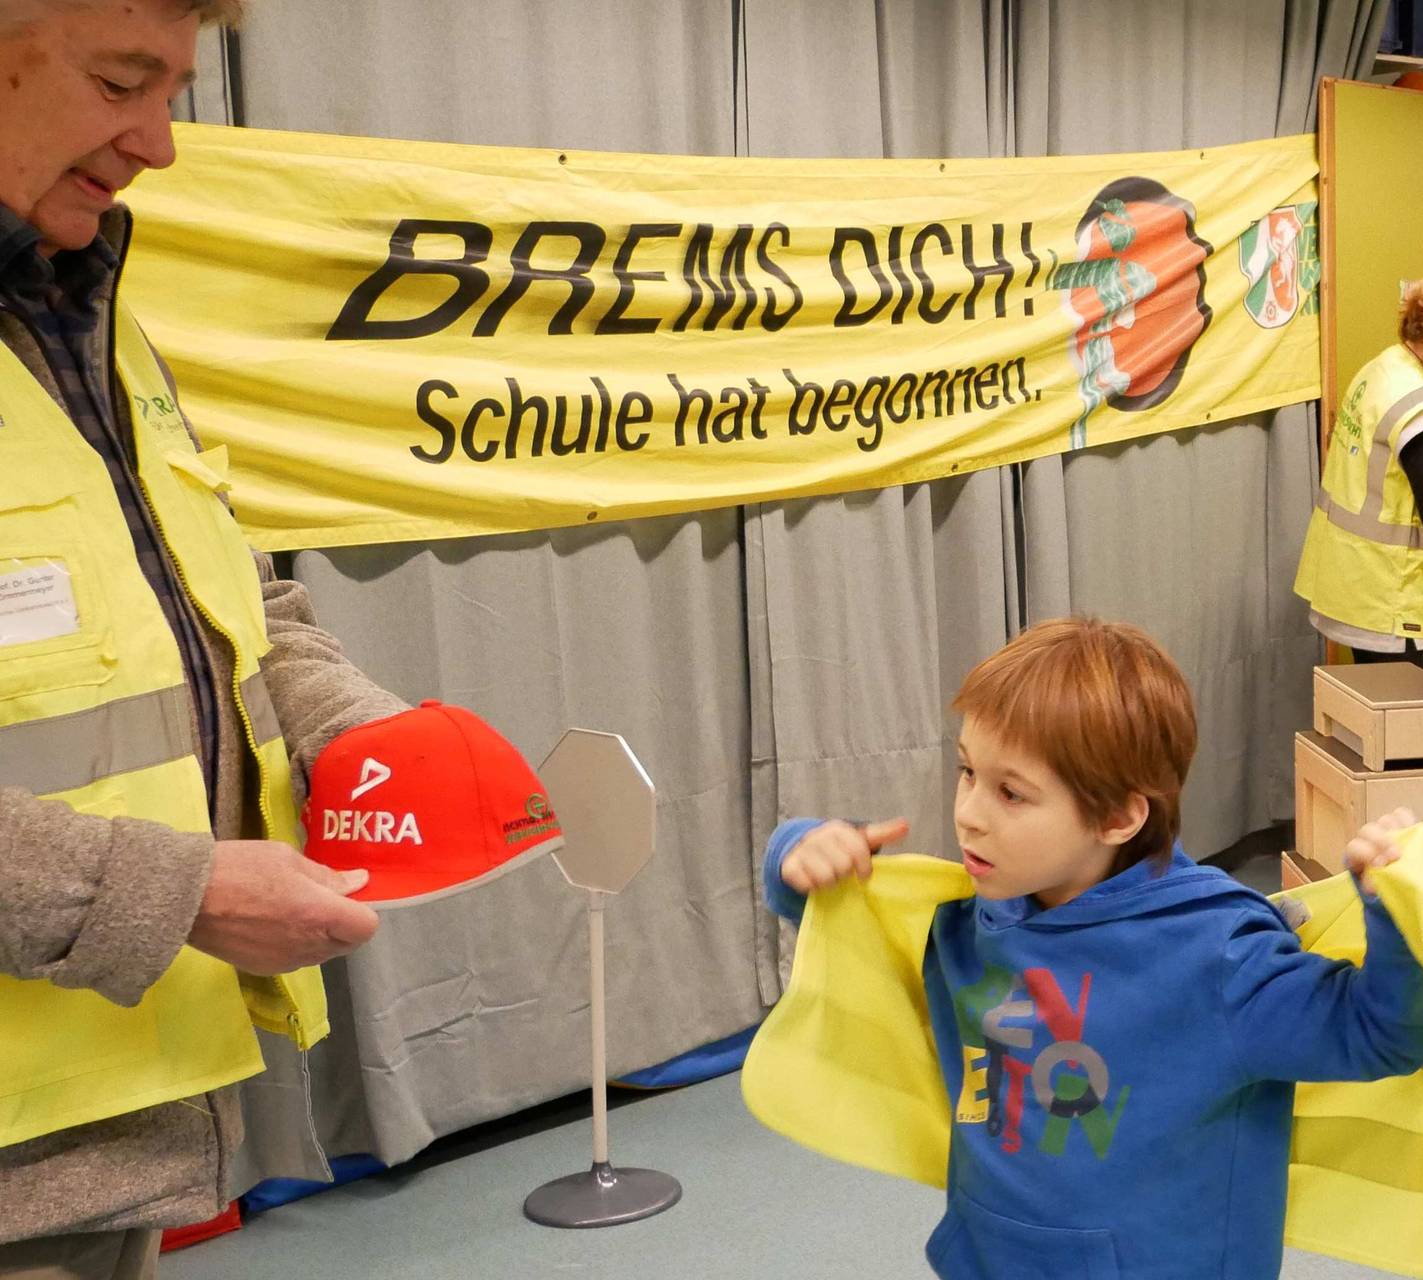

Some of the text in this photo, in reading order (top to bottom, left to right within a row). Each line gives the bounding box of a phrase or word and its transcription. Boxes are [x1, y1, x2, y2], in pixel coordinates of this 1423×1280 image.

[325, 218, 1041, 342] BREMS DICH!
[409, 355, 1042, 465] Schule hat begonnen.
[322, 809, 423, 845] DEKRA
